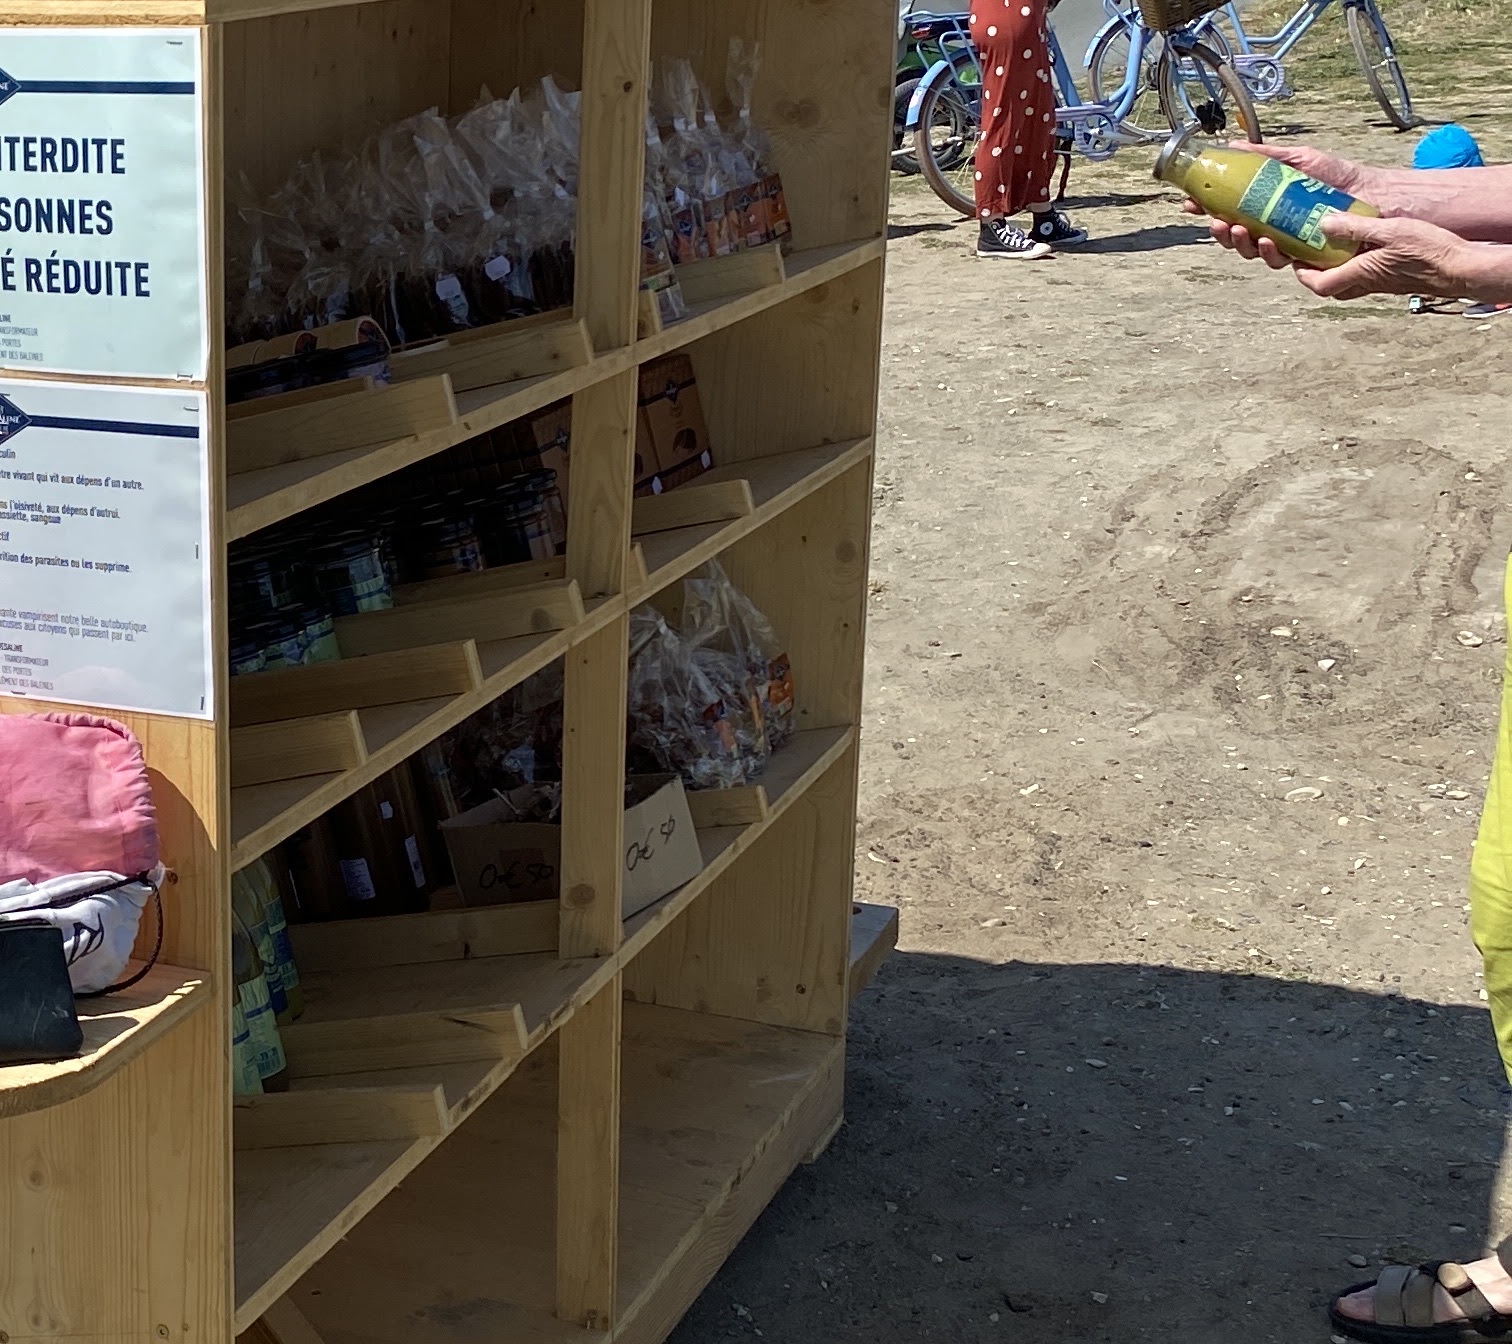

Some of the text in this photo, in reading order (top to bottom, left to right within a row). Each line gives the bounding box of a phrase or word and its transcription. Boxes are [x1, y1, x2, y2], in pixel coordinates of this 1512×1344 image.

[25, 249, 150, 297] RÉDUITE
[37, 473, 48, 484] qui
[60, 613, 79, 625] notre
[81, 614, 98, 627] belle
